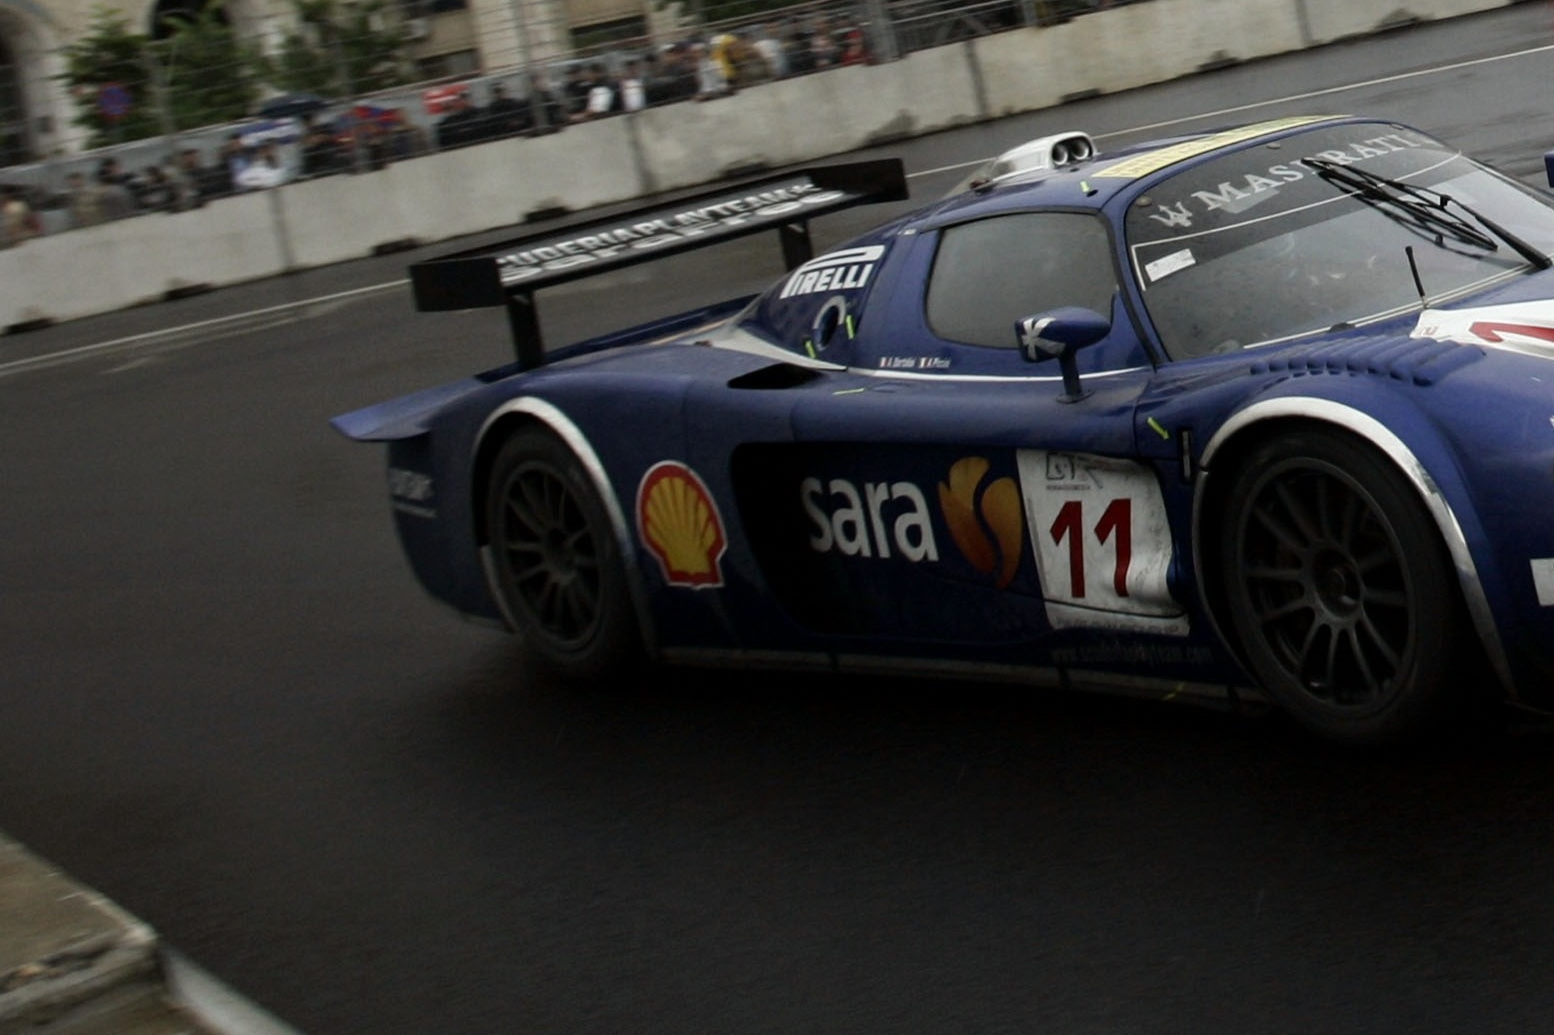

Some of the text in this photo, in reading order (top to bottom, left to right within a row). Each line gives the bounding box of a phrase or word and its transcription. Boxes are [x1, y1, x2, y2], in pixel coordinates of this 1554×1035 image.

[1191, 134, 1413, 211] MASRATI
[780, 245, 885, 299] PIRELLI
[801, 477, 939, 562] sara
[1050, 498, 1131, 598] 11
